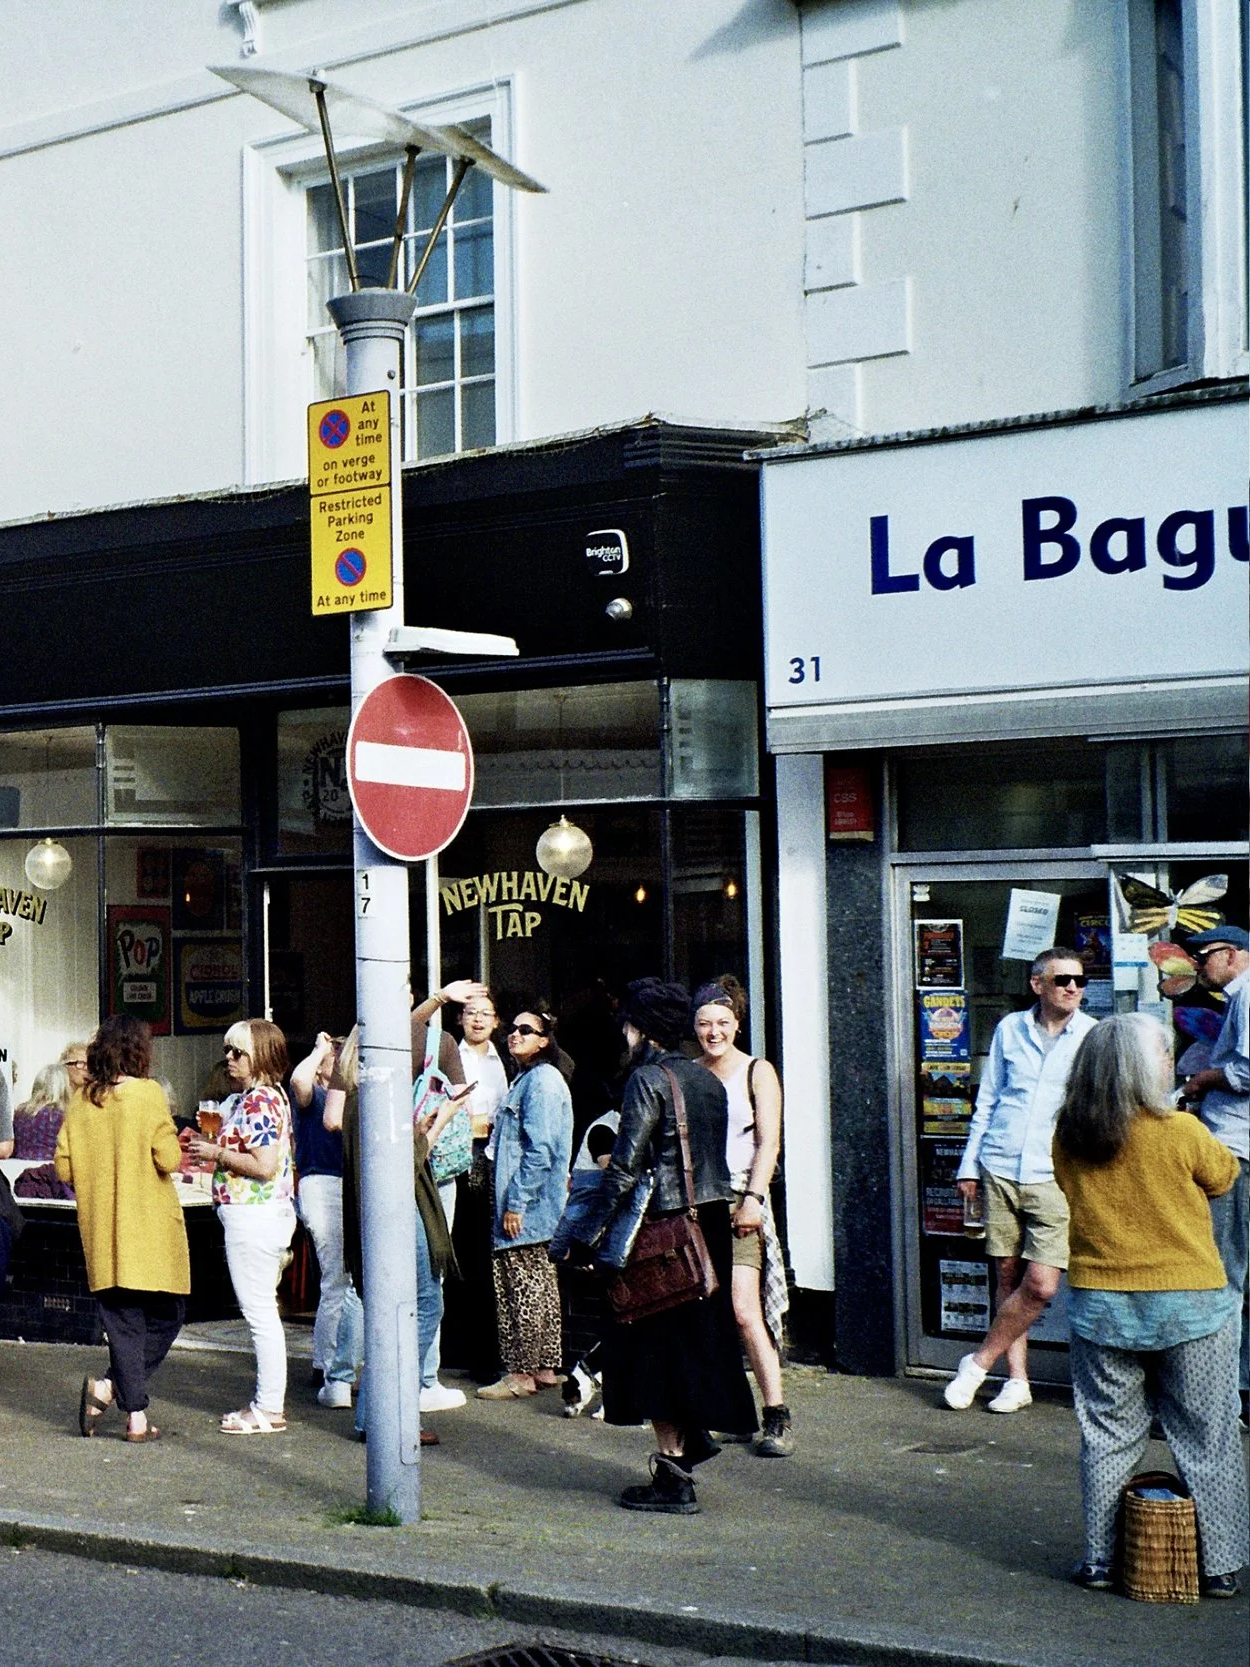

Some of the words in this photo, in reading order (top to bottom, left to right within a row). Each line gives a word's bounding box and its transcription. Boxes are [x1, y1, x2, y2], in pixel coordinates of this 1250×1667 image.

[361, 400, 376, 413] At
[357, 418, 380, 430] any
[355, 433, 383, 446] time
[323, 460, 338, 471] on
[342, 454, 376, 467] verge
[316, 477, 329, 487] or
[333, 468, 383, 484] footway
[319, 493, 382, 513] Restricted
[328, 513, 374, 527] Parking
[336, 530, 365, 542] Zone
[585, 545, 621, 558] Brighton
[869, 514, 977, 596] La
[317, 595, 331, 607] At
[334, 594, 356, 606] any
[360, 590, 386, 603] time
[788, 656, 821, 685] 31
[302, 730, 348, 774] NEWHAV
[361, 873, 369, 890] 1
[440, 871, 590, 916] NEWHAVEN
[361, 897, 371, 914] 7
[488, 902, 542, 940] TAP
[117, 929, 160, 968] POP
